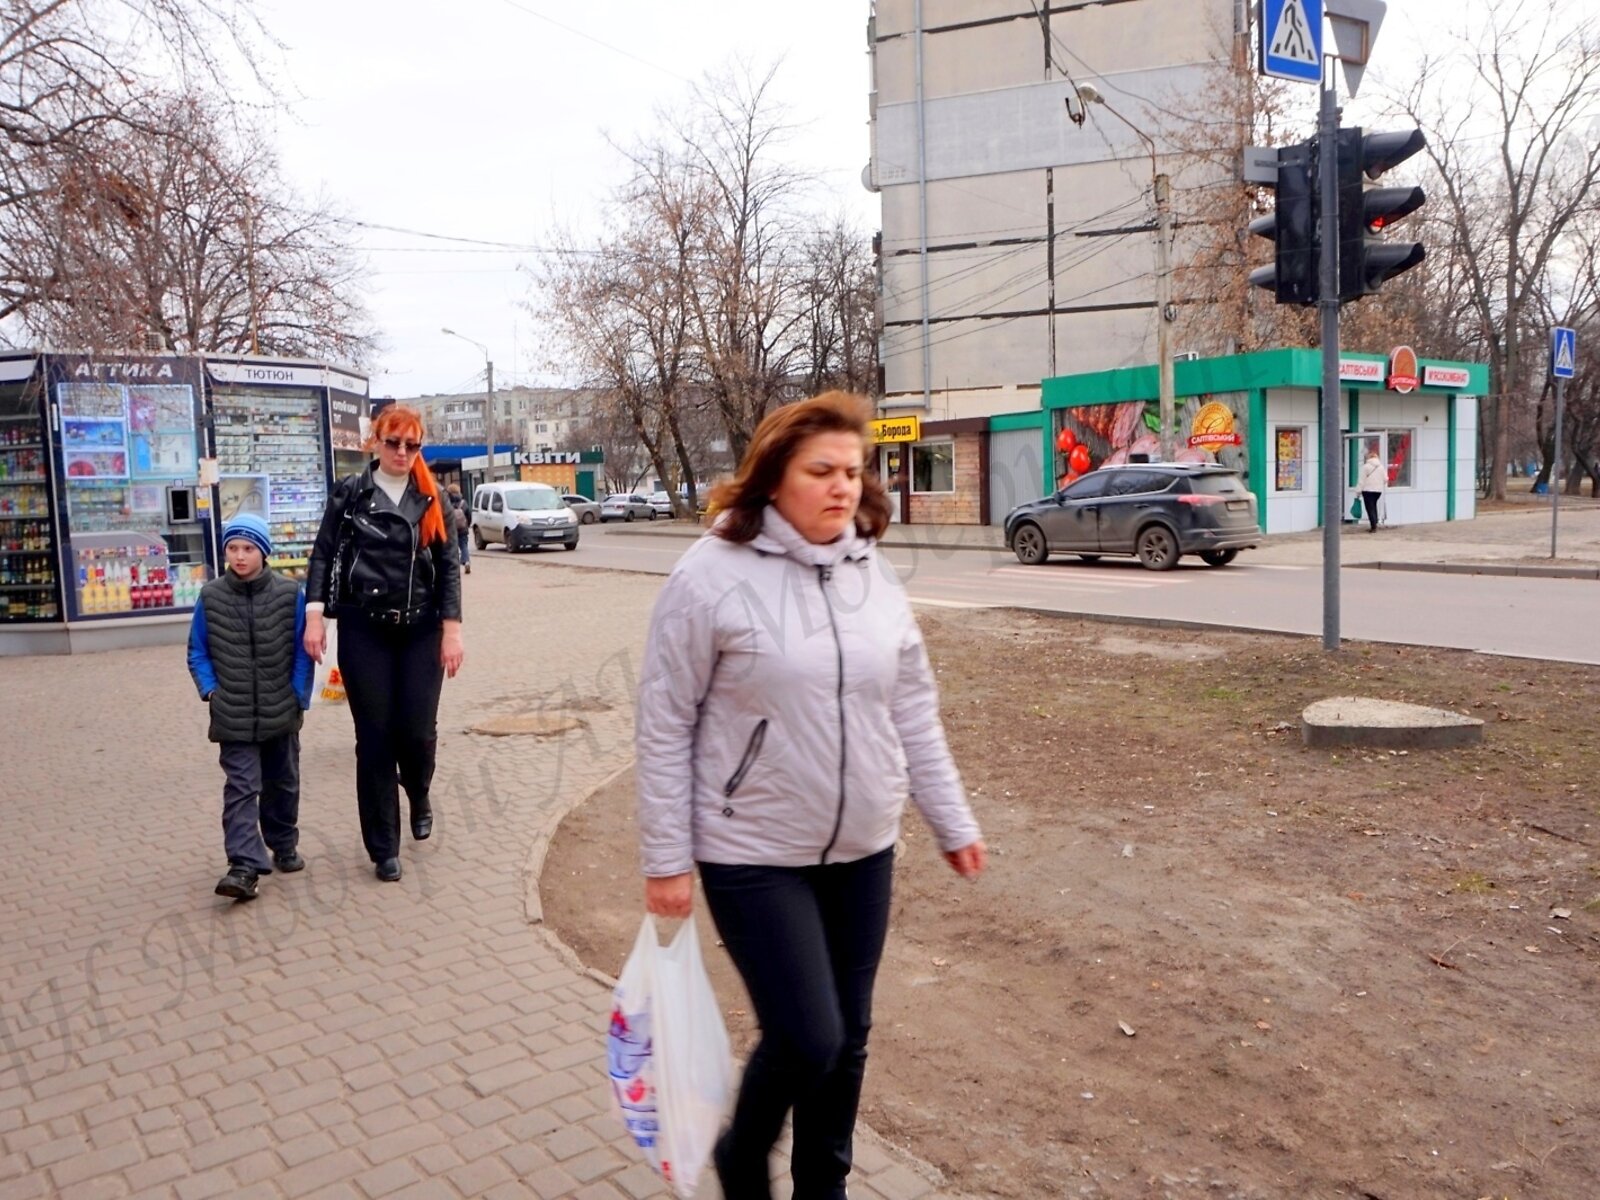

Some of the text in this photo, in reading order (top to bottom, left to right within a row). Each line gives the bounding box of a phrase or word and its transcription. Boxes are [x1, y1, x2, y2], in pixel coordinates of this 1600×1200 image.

[75, 362, 173, 378] АТТИКА
[245, 368, 294, 381] ТЮТЮН
[882, 424, 911, 439] Борода
[514, 451, 580, 465] КВІТИ
